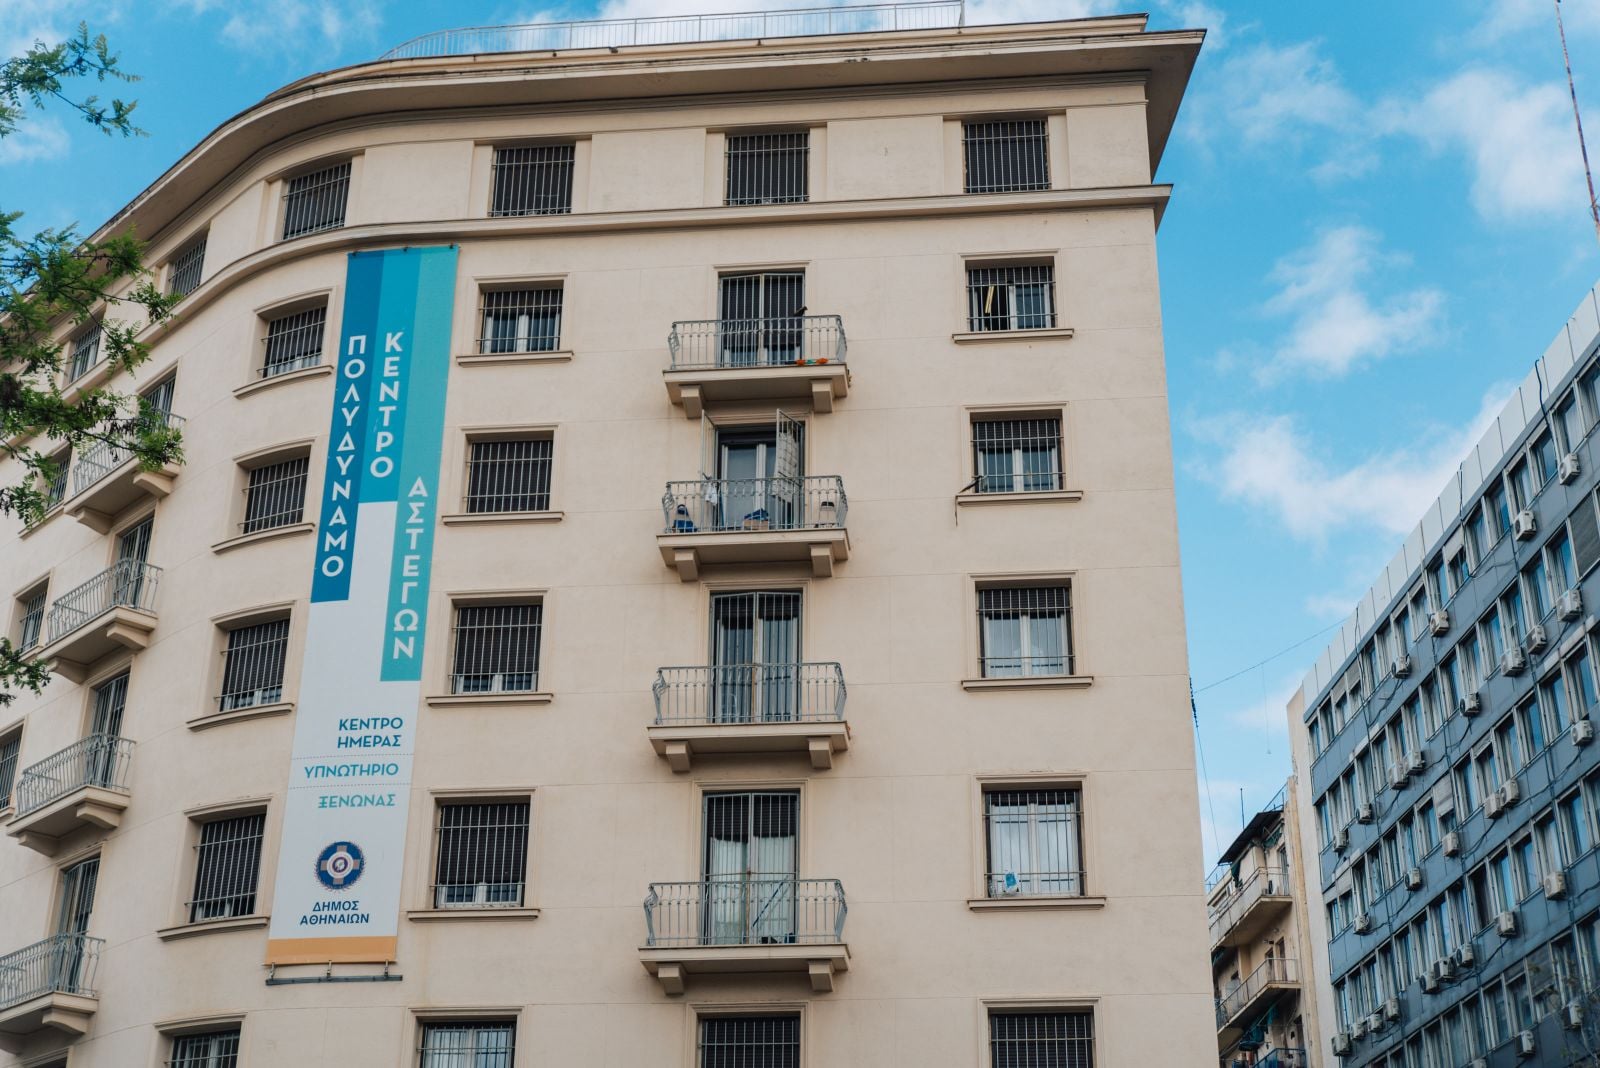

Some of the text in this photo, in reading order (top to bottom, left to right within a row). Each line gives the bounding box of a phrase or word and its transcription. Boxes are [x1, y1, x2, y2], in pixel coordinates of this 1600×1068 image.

[369, 332, 404, 479] ΚΕΝΤΡΟ
[321, 334, 367, 578] ΠΟΛΥΔΥΝΑΜΟ
[392, 475, 429, 660] ΑΣΤΕΓΩΝ
[338, 717, 403, 731] ΚΕΝΤΡΟ
[337, 734, 402, 749] ΗΜΕΡΑΣ
[303, 762, 399, 779] ΥΠΝΩΤΗΡΙΟ
[317, 794, 396, 809] ΞΕΝΩΝΑΣ
[312, 900, 360, 912] ΔΗΜΟΣ
[299, 913, 370, 926] ΑΘΗΝΑΙΩΝ
